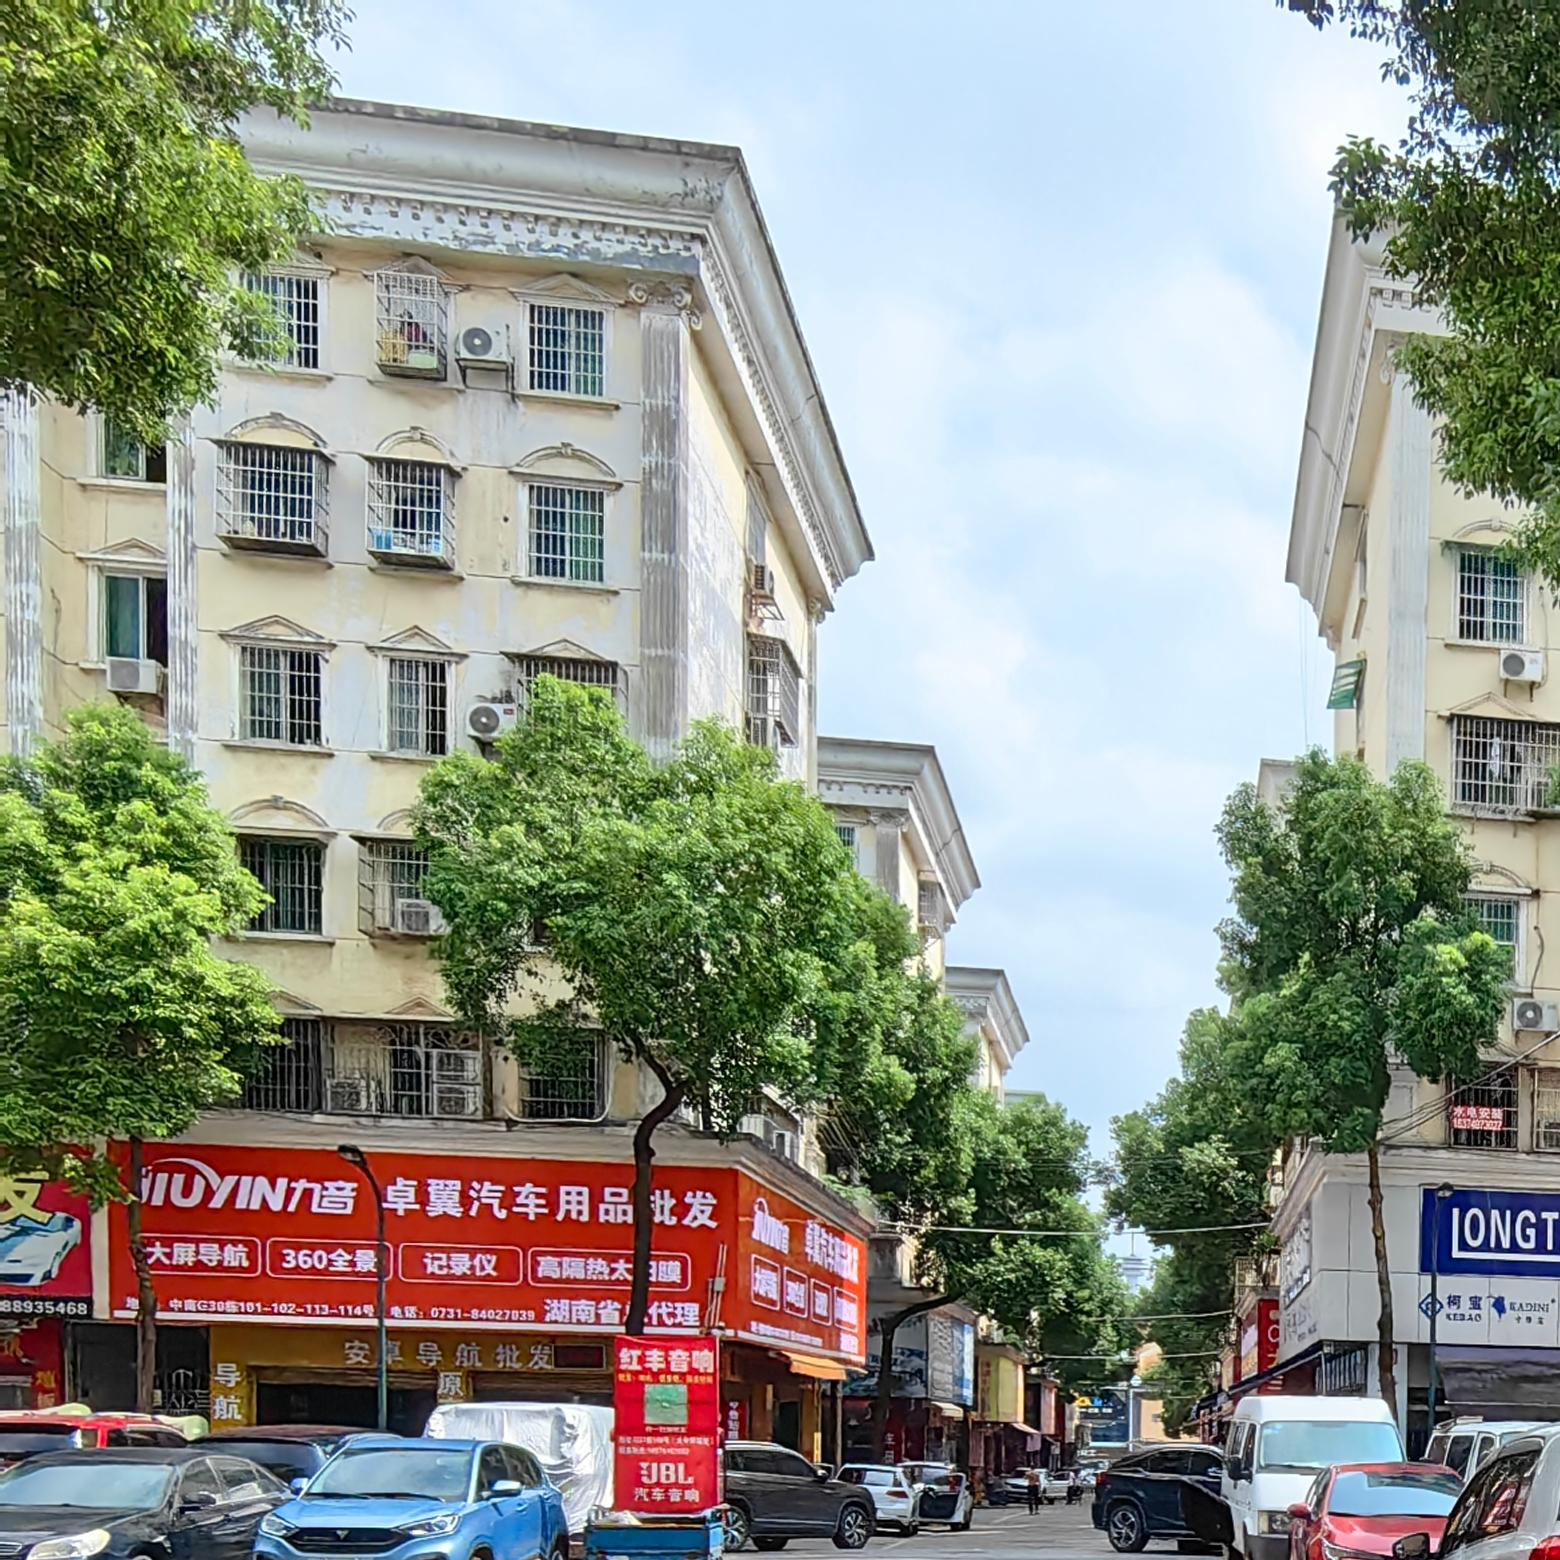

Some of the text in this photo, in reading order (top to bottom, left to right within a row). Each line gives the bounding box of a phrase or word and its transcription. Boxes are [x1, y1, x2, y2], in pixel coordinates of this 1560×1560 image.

[287, 1180, 358, 1215] 九音
[382, 1176, 719, 1229] 卓翼汽车用品批发
[145, 1242, 251, 1269] 大屏导航
[280, 1248, 379, 1274] 360全景
[423, 1252, 499, 1278] 记录仪
[543, 1298, 701, 1327] 湖南省代理
[344, 1340, 552, 1370] 安卓导航批发
[618, 1347, 714, 1374] 红丰音响
[638, 1461, 695, 1485] JBL
[633, 1487, 701, 1503] 汽车音响
